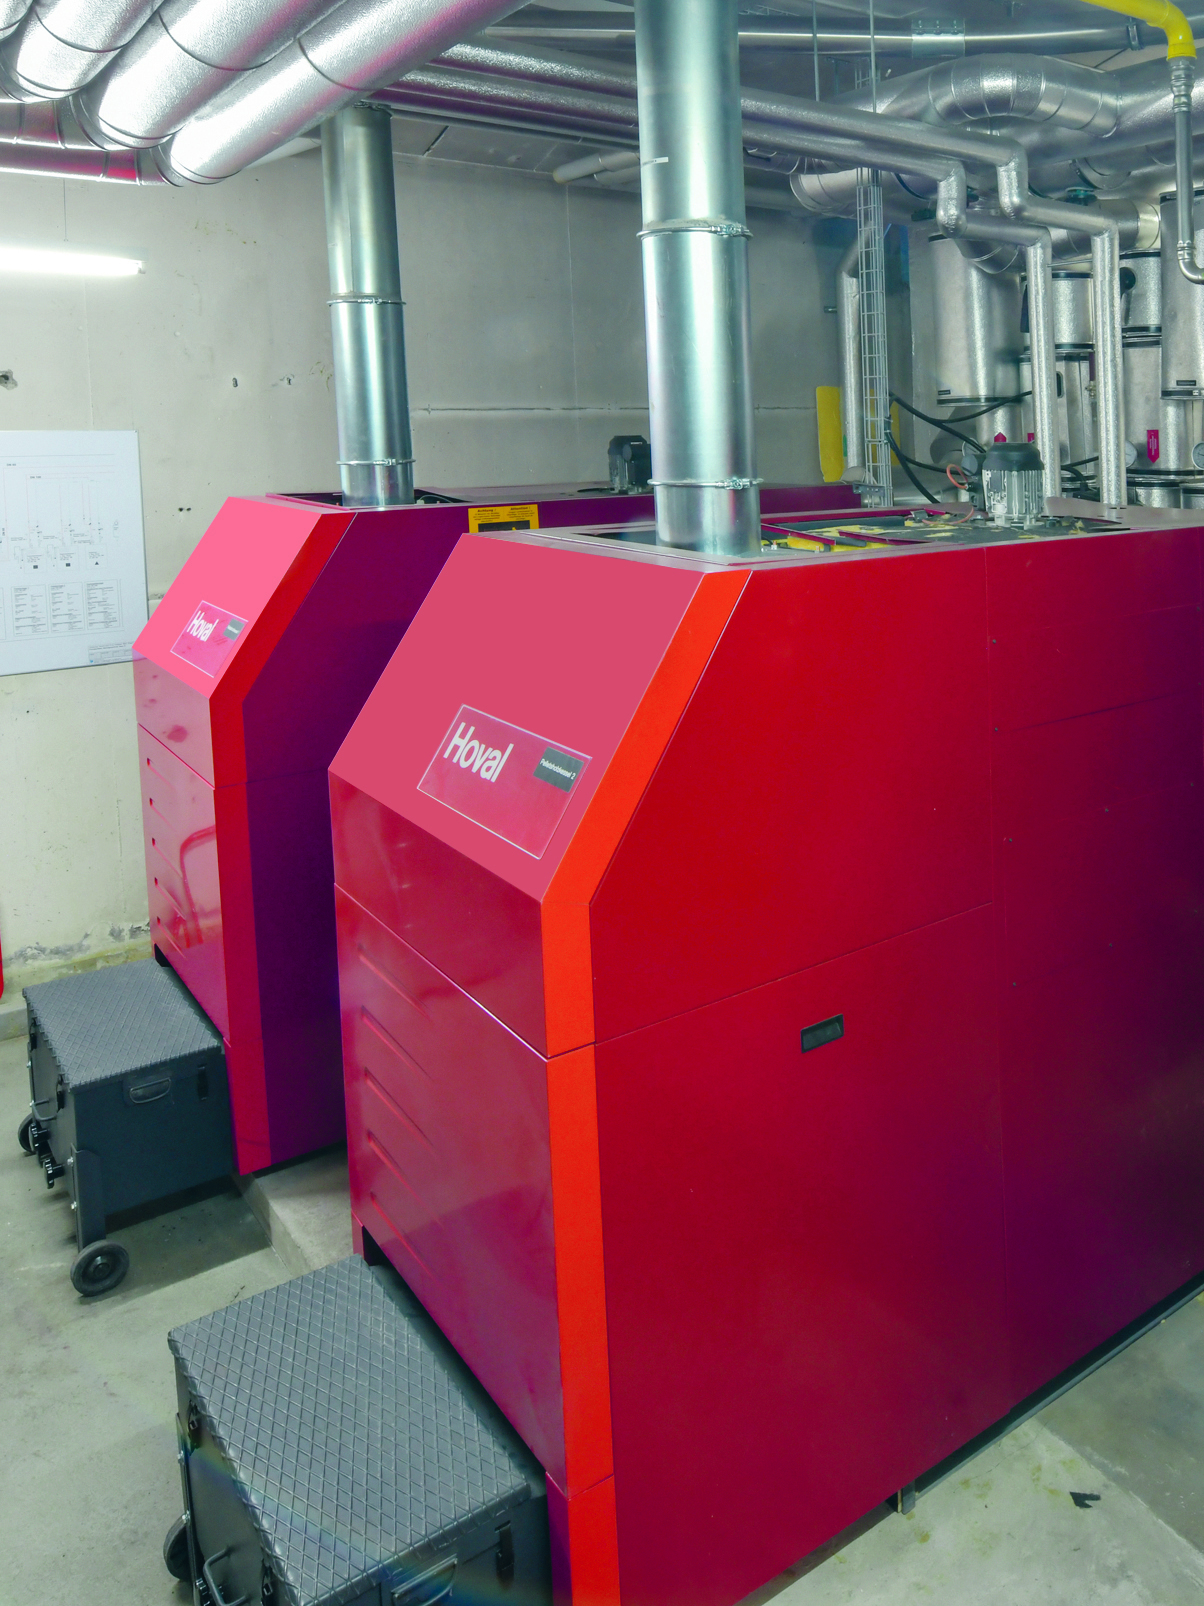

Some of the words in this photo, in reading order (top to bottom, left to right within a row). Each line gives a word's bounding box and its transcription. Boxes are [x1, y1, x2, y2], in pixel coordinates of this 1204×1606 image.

[186, 610, 220, 642] Hoval
[443, 721, 514, 783] Hoval
[570, 772, 576, 780] 2
